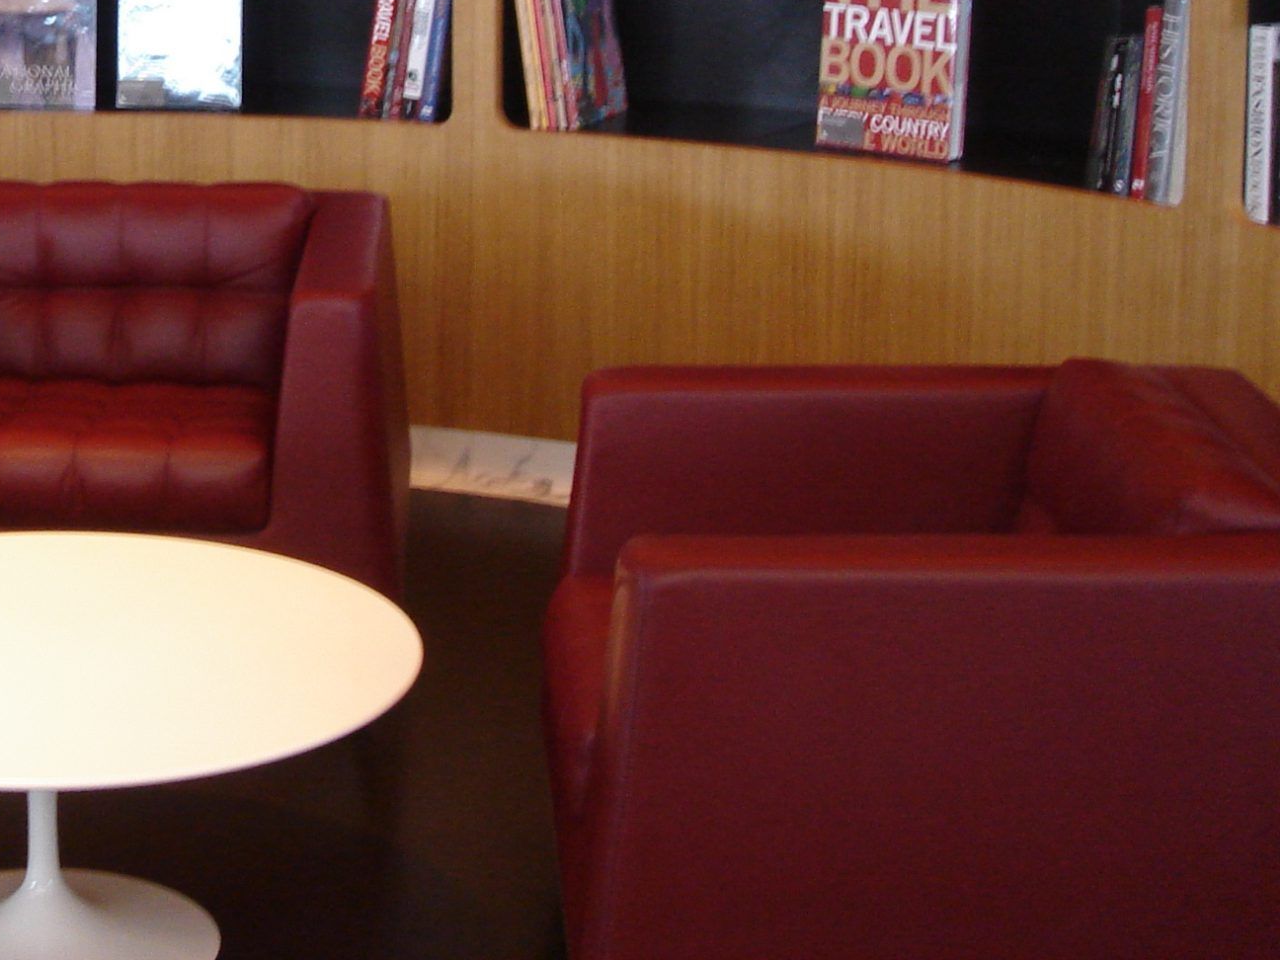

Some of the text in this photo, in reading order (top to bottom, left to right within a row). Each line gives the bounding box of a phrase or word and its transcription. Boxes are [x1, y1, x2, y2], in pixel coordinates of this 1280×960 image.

[823, 3, 957, 52] TRAVEL
[363, 43, 388, 97] BOOK
[819, 37, 955, 104] BOOK
[869, 113, 950, 141] COUNTRY
[880, 133, 950, 160] WORLD
